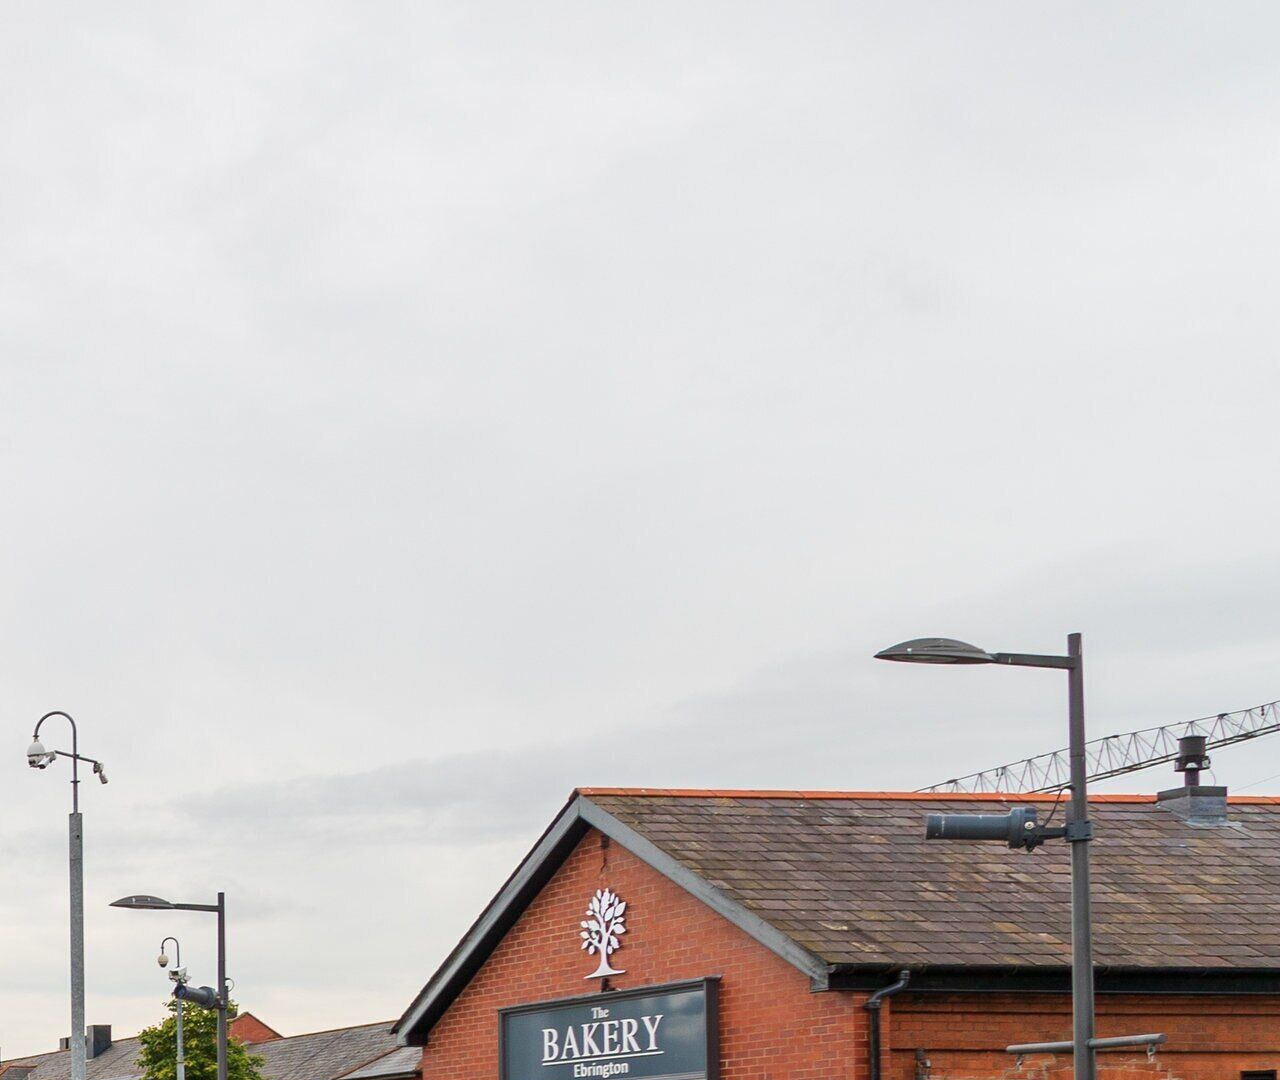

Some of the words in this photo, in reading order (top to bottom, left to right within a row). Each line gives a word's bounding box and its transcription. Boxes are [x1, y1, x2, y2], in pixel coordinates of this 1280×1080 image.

[591, 1006, 610, 1019] The
[542, 1015, 664, 1062] BAKERY
[574, 1062, 629, 1078] Ebrington
